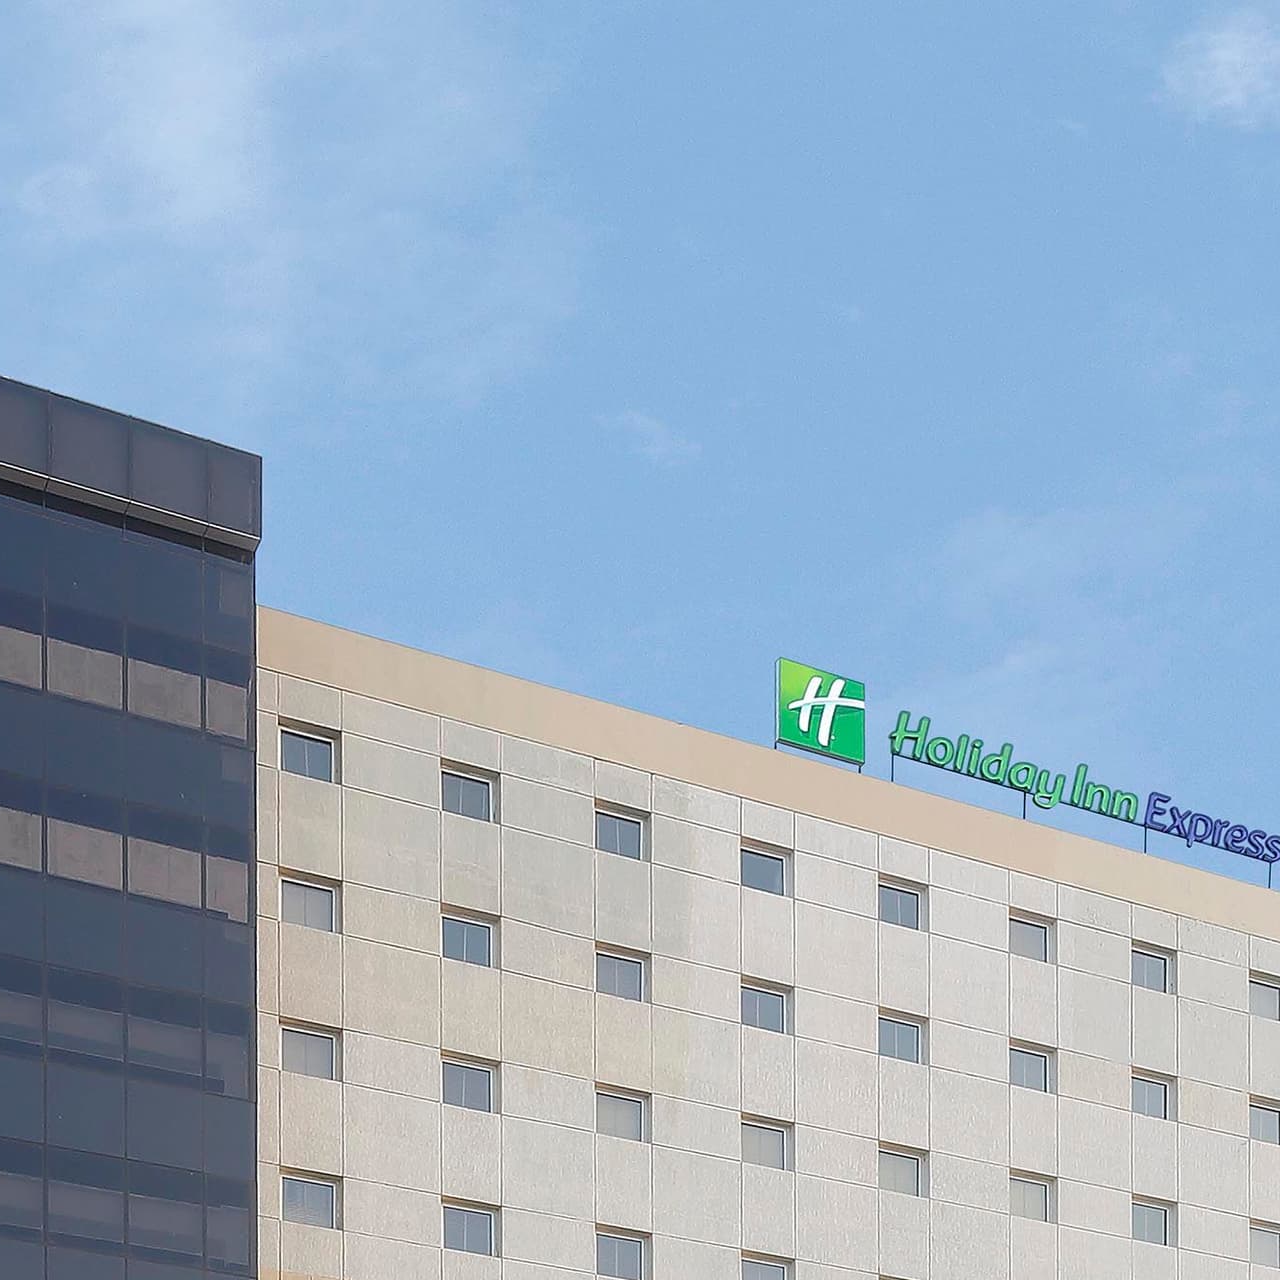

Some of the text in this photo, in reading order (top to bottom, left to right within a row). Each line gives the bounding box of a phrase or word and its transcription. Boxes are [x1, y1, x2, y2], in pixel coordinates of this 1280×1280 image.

[788, 676, 865, 747] H
[889, 711, 1066, 809] Holiday
[1073, 763, 1138, 823] Inn
